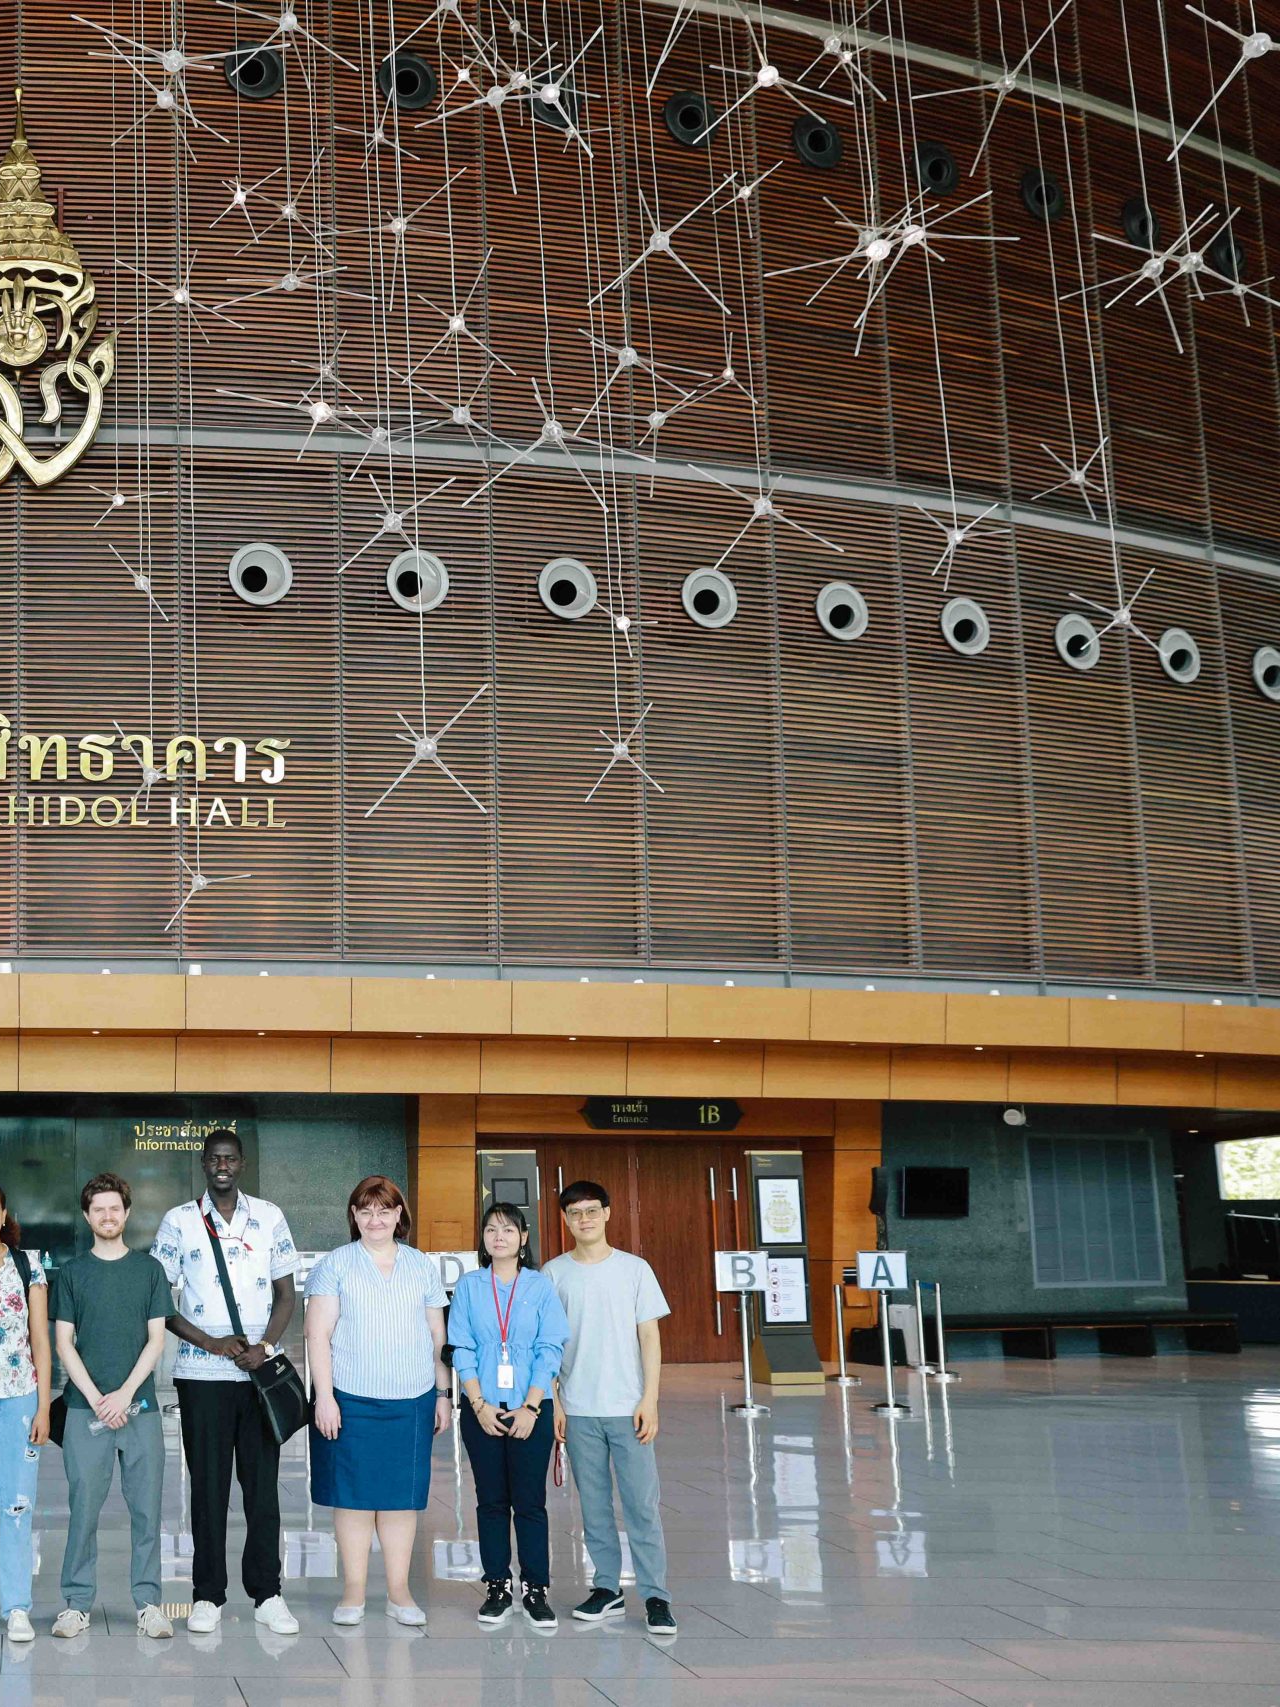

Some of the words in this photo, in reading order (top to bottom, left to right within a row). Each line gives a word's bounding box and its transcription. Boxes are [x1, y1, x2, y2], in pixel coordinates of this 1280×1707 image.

[169, 795, 288, 829] HALL
[698, 1104, 720, 1124] 1B
[134, 1138, 205, 1152] Informatio
[440, 1255, 465, 1288] D
[731, 1255, 757, 1288] B
[871, 1255, 895, 1287] A
